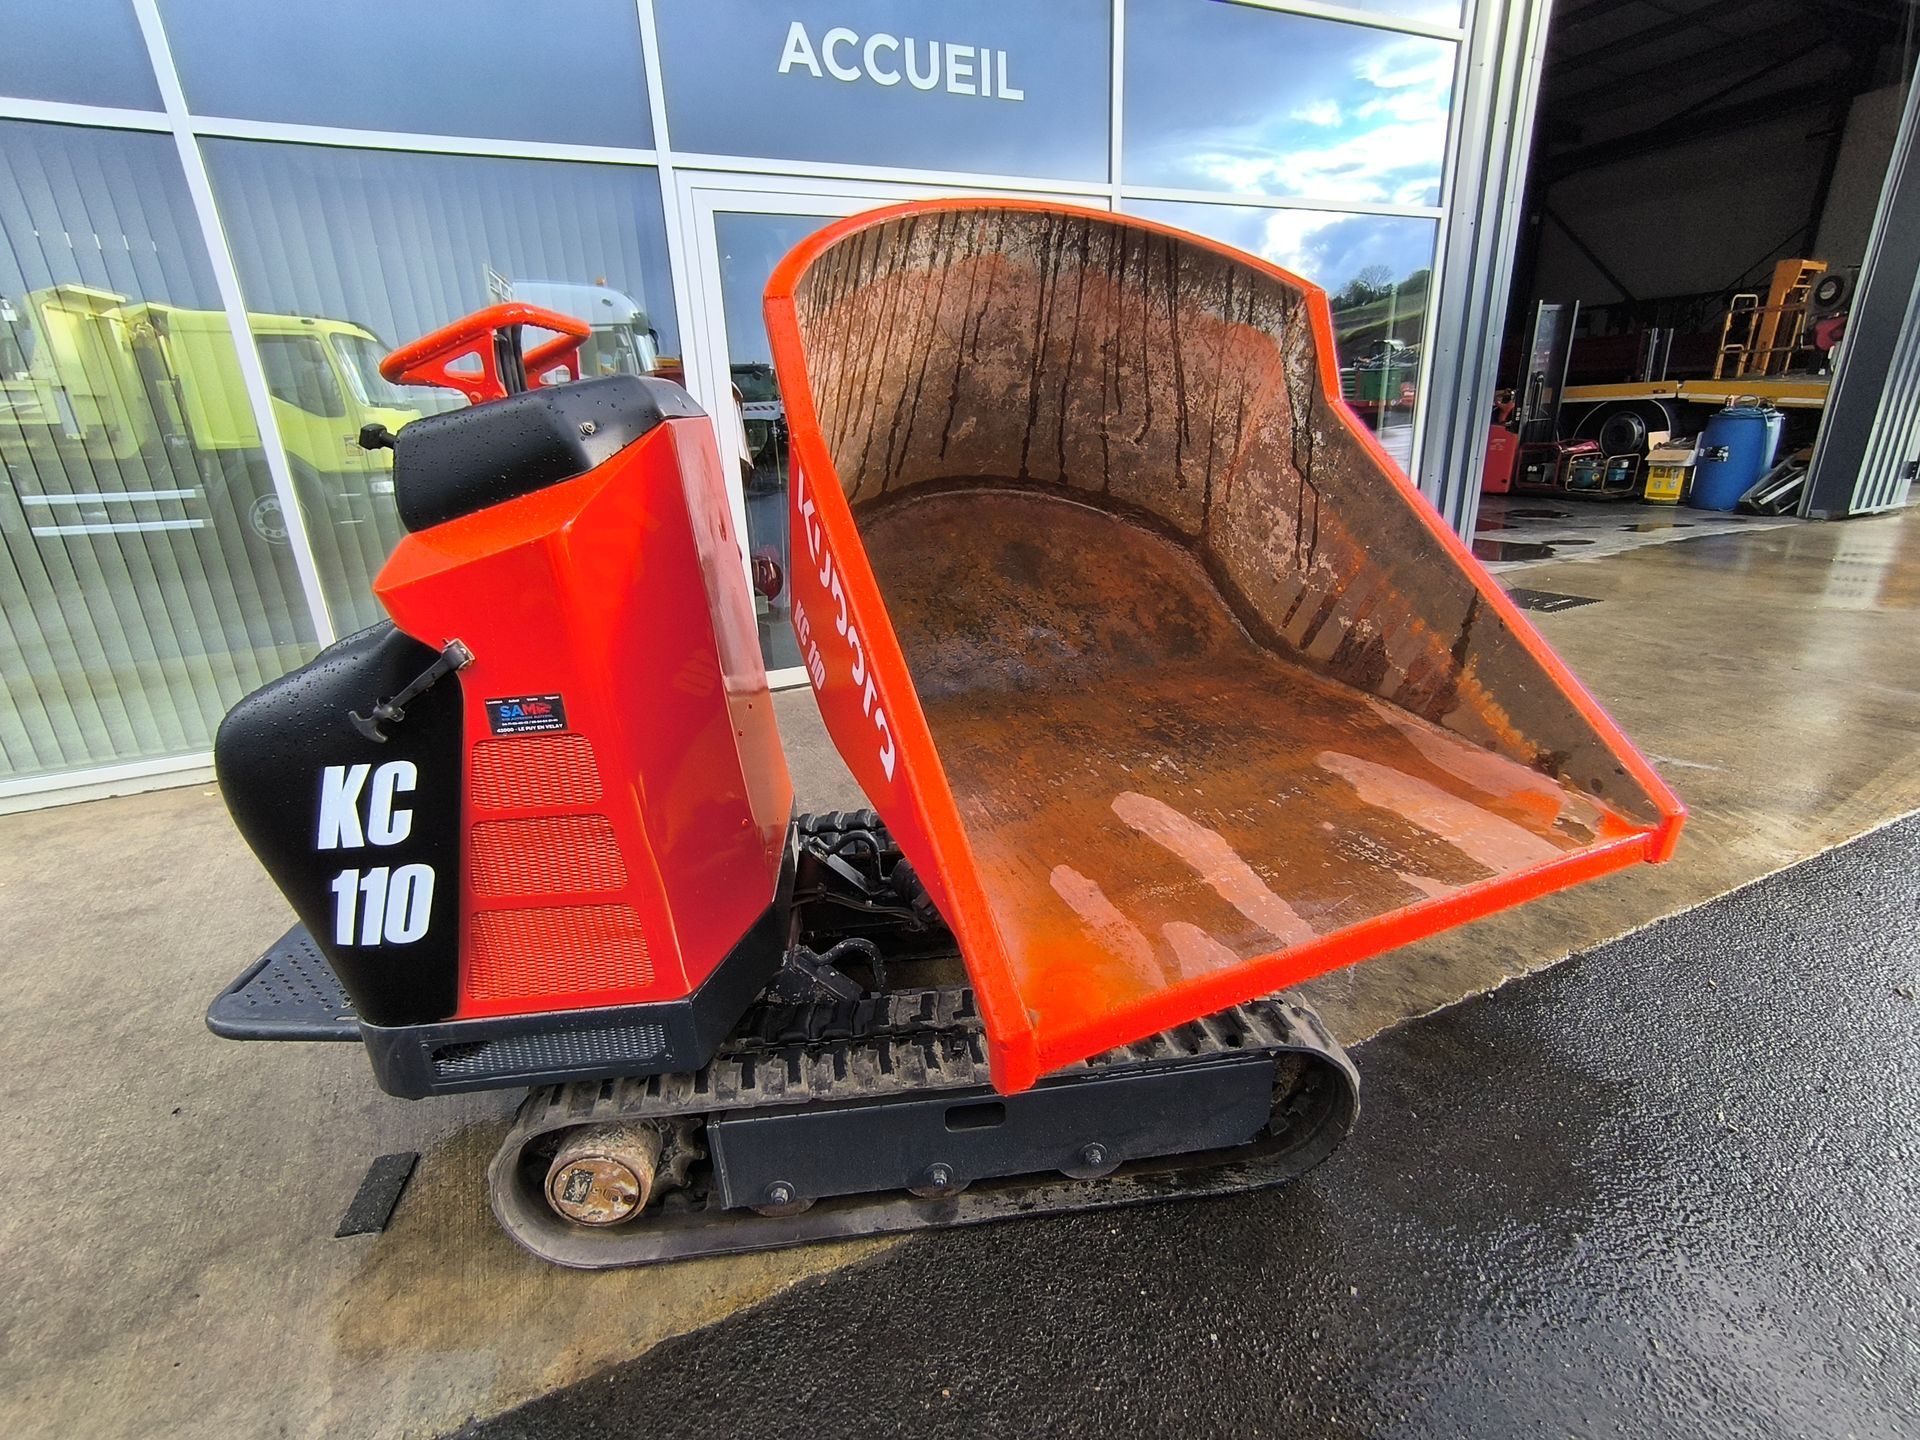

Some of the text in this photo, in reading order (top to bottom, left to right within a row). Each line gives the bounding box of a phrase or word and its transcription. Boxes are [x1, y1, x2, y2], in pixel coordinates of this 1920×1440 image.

[777, 20, 1025, 101] ACCUEIL
[794, 599, 826, 691] KC 110
[317, 760, 418, 850] KC
[331, 863, 436, 946] 110
